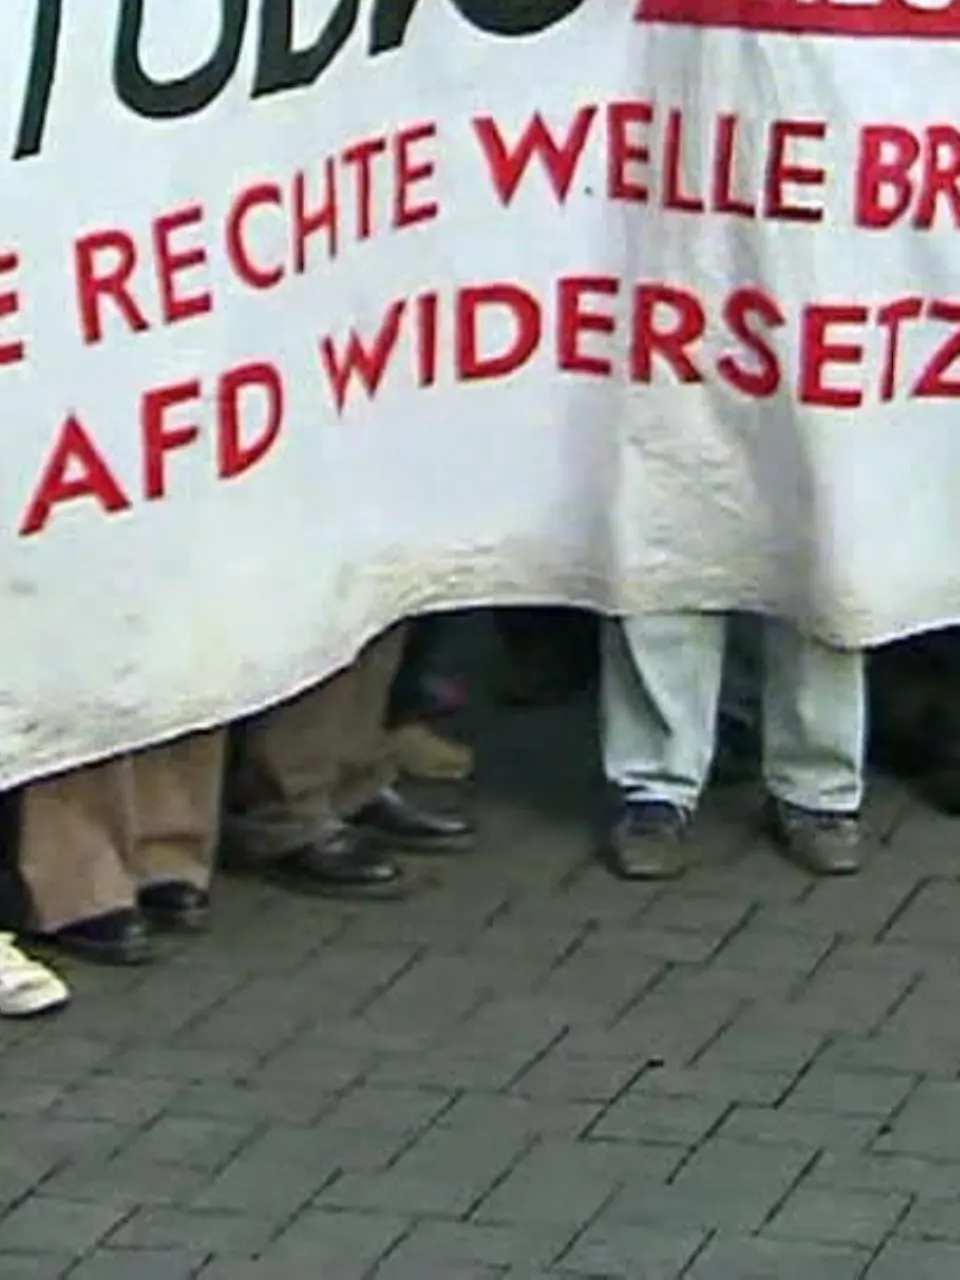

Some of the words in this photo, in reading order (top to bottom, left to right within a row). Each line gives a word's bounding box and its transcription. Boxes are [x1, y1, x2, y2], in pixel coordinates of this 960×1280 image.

[74, 122, 439, 346] RECHTE
[470, 101, 827, 222] WELLE
[853, 123, 960, 231] BR
[19, 361, 284, 537] AFD
[320, 275, 960, 418] WIDERSETZ
